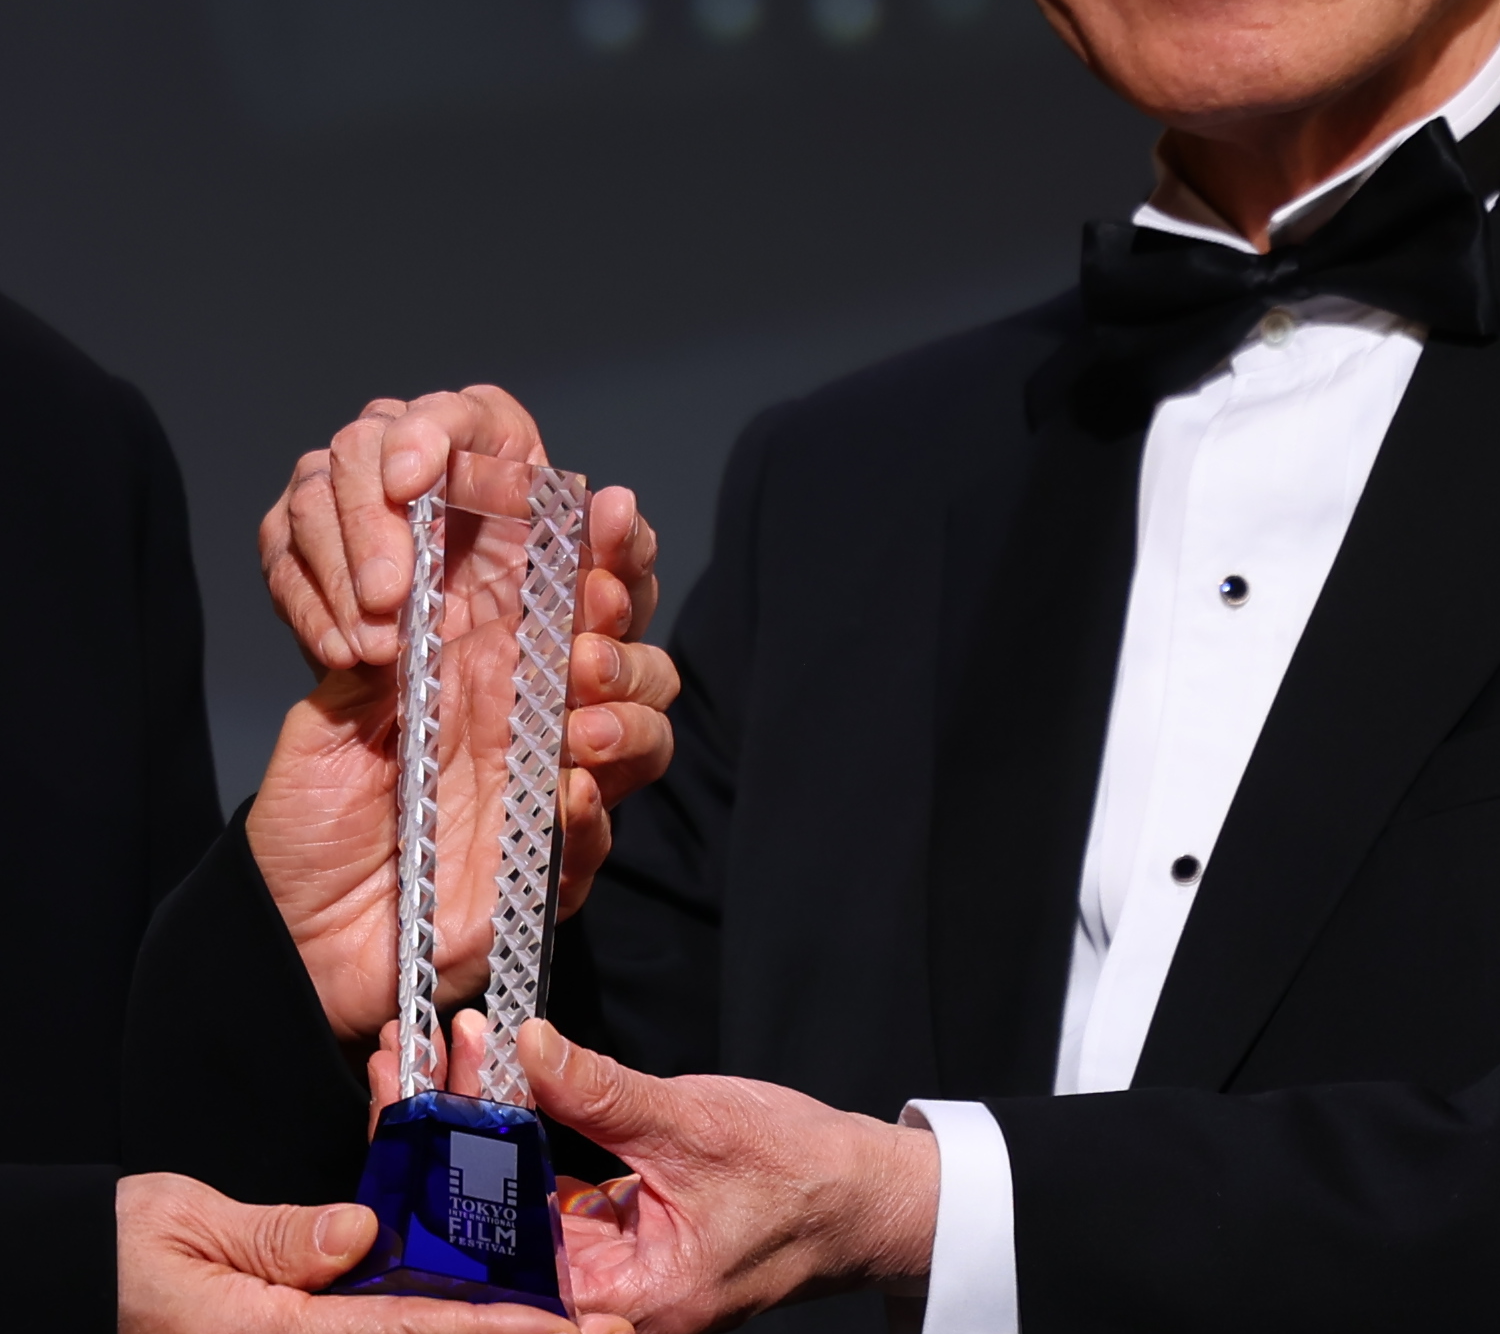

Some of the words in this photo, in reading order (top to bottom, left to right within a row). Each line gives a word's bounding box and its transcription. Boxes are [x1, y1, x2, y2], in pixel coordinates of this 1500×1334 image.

[449, 1196, 517, 1221] TOKYO
[449, 1208, 516, 1228] INTERNATIONAL
[449, 1217, 516, 1247] FILM
[449, 1235, 516, 1256] FESTIVAL
